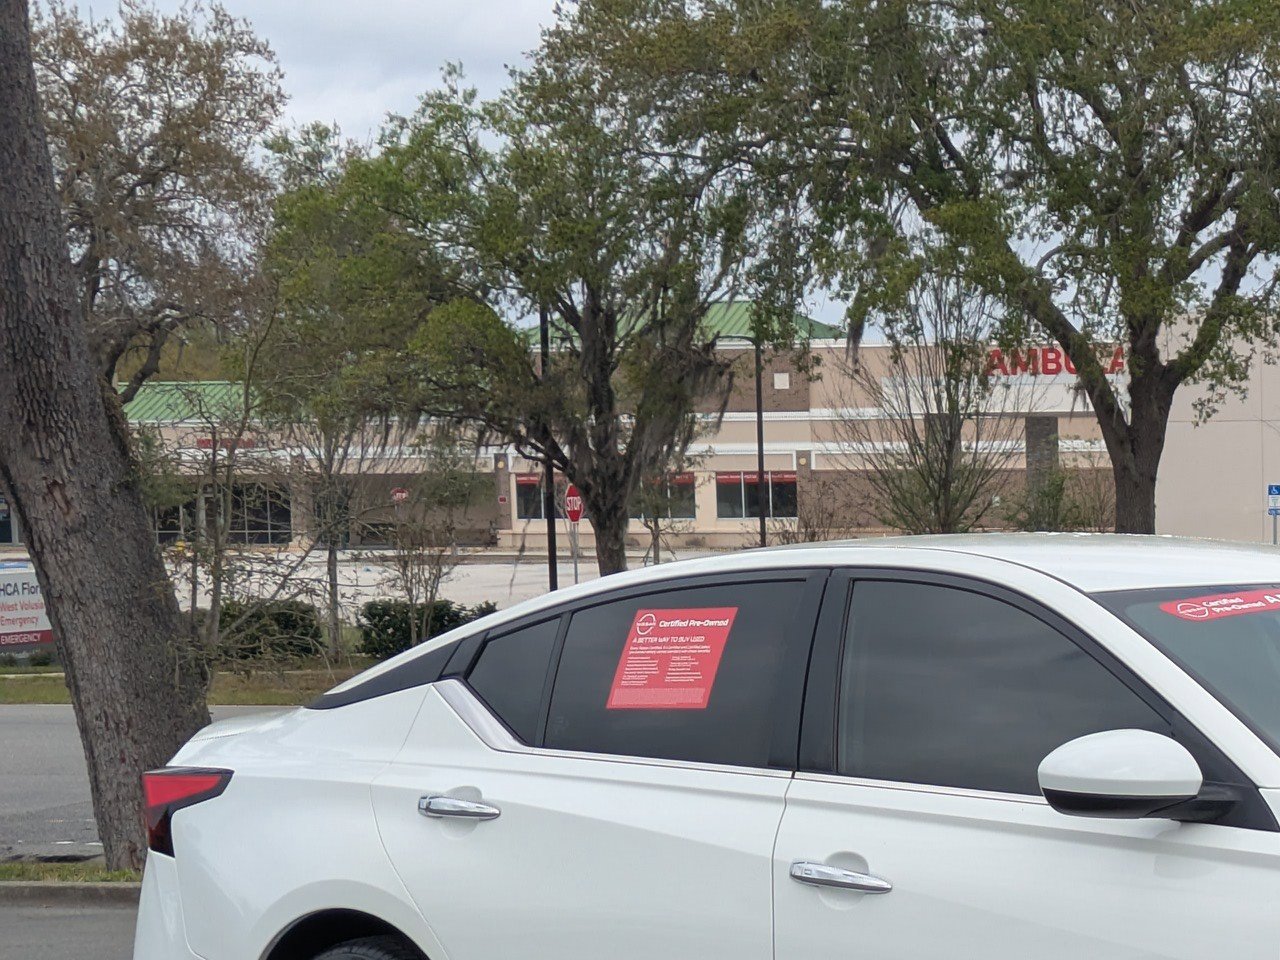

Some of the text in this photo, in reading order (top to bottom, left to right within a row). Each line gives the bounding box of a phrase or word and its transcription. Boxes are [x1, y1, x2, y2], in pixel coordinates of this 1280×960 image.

[567, 496, 581, 511] STOP
[0, 583, 19, 596] HCA
[1203, 598, 1244, 606] Certified
[1263, 595, 1276, 604] A
[1213, 601, 1265, 612] Pre-Owned
[1, 616, 39, 628] Emergency
[659, 618, 729, 628] Certified Pre-Owned
[1, 634, 40, 645] EMERGENCY
